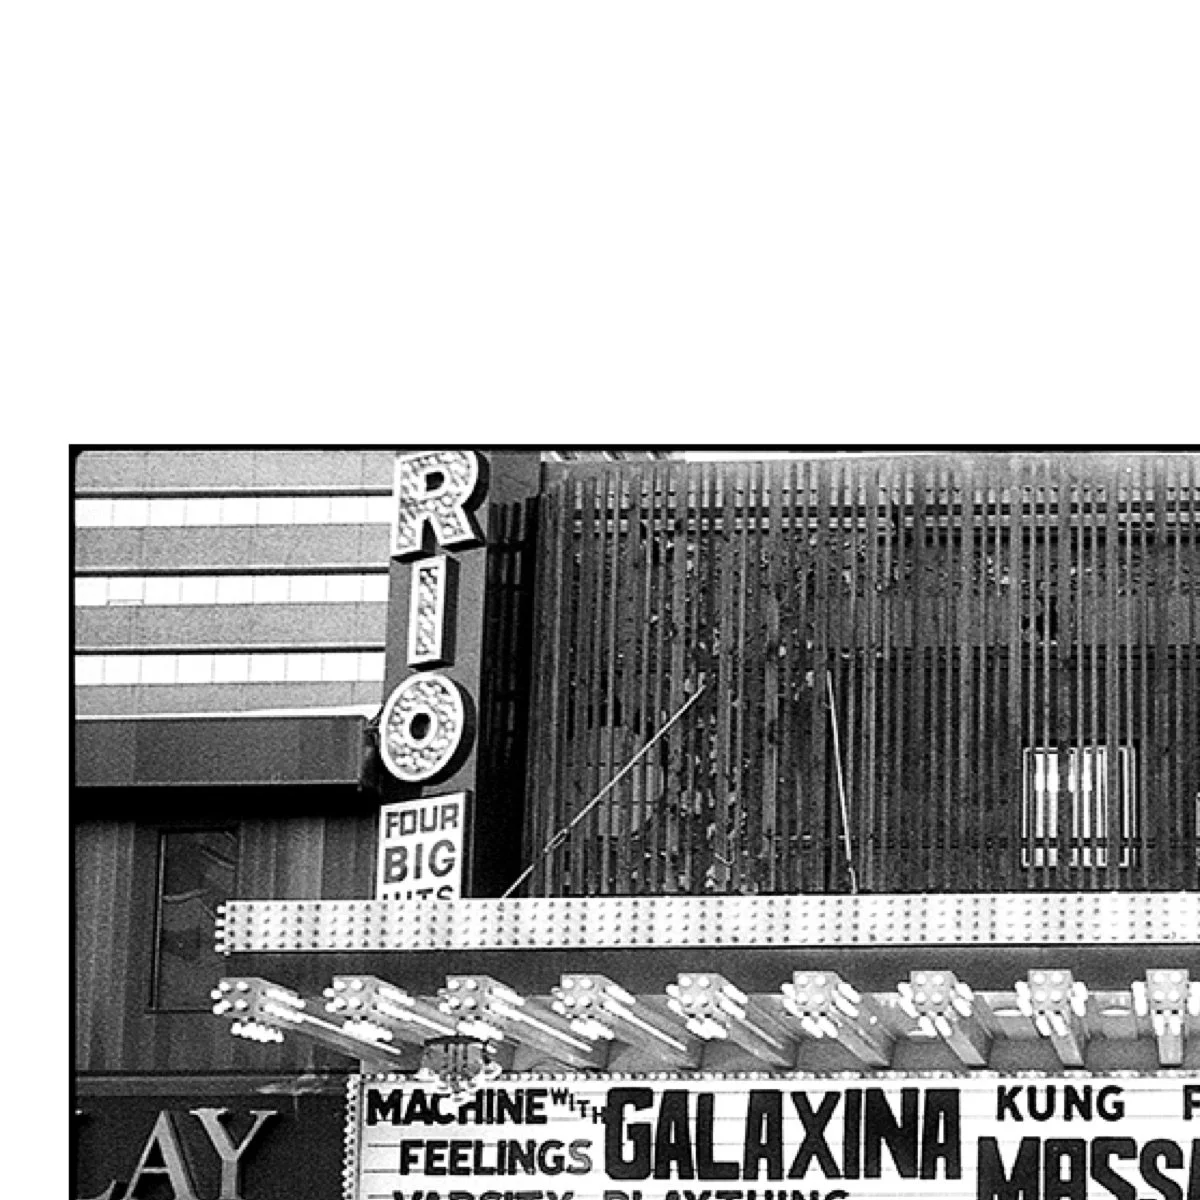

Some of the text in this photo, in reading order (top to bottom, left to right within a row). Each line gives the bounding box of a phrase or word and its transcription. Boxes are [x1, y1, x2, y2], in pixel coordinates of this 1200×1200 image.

[380, 450, 476, 782] RIO
[385, 804, 459, 838] FOUR
[384, 840, 456, 884] BIG
[997, 1084, 1126, 1122] KUNG
[366, 1087, 961, 1181] MACHINE WITH GALAXINA
[400, 1139, 592, 1176] FEELINGS
